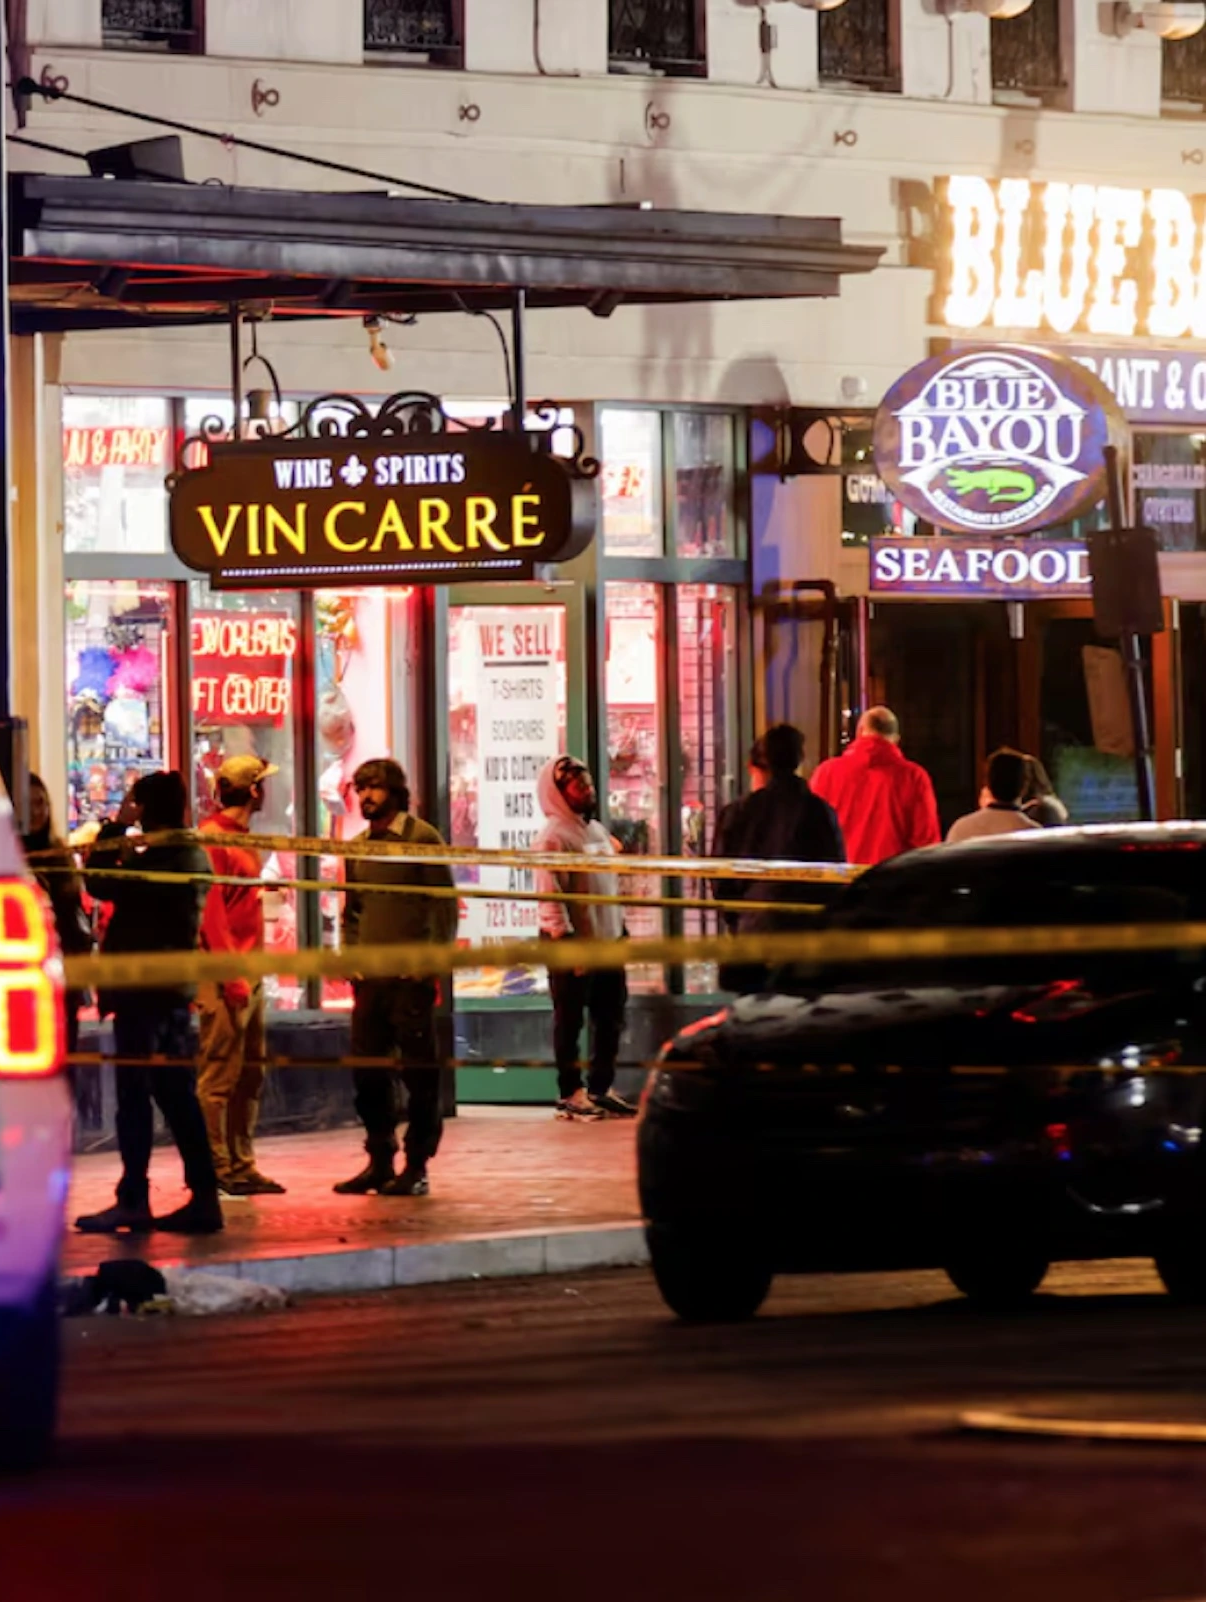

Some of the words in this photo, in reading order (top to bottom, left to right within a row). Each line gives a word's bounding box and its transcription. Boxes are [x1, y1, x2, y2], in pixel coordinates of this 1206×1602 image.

[944, 174, 1144, 337] BLUE
[1146, 188, 1206, 340] B
[937, 379, 1047, 410] BLUE
[1071, 356, 1161, 409] ANT
[898, 413, 1085, 468] BAYOU
[273, 458, 332, 489] WINE
[374, 453, 465, 486] SPIRITS
[196, 502, 307, 557] VIN
[323, 482, 545, 553] CARRÉ
[479, 624, 505, 656] WE
[513, 623, 552, 656] SELL
[221, 674, 291, 716] CENTER
[491, 678, 544, 701] T-SHIRTS
[492, 719, 545, 742] SOUVENIRS
[485, 756, 508, 781] KID'S
[511, 755, 551, 781] CLOTH
[504, 793, 534, 818] HATS
[508, 866, 534, 892] ATM
[485, 902, 507, 927] 723
